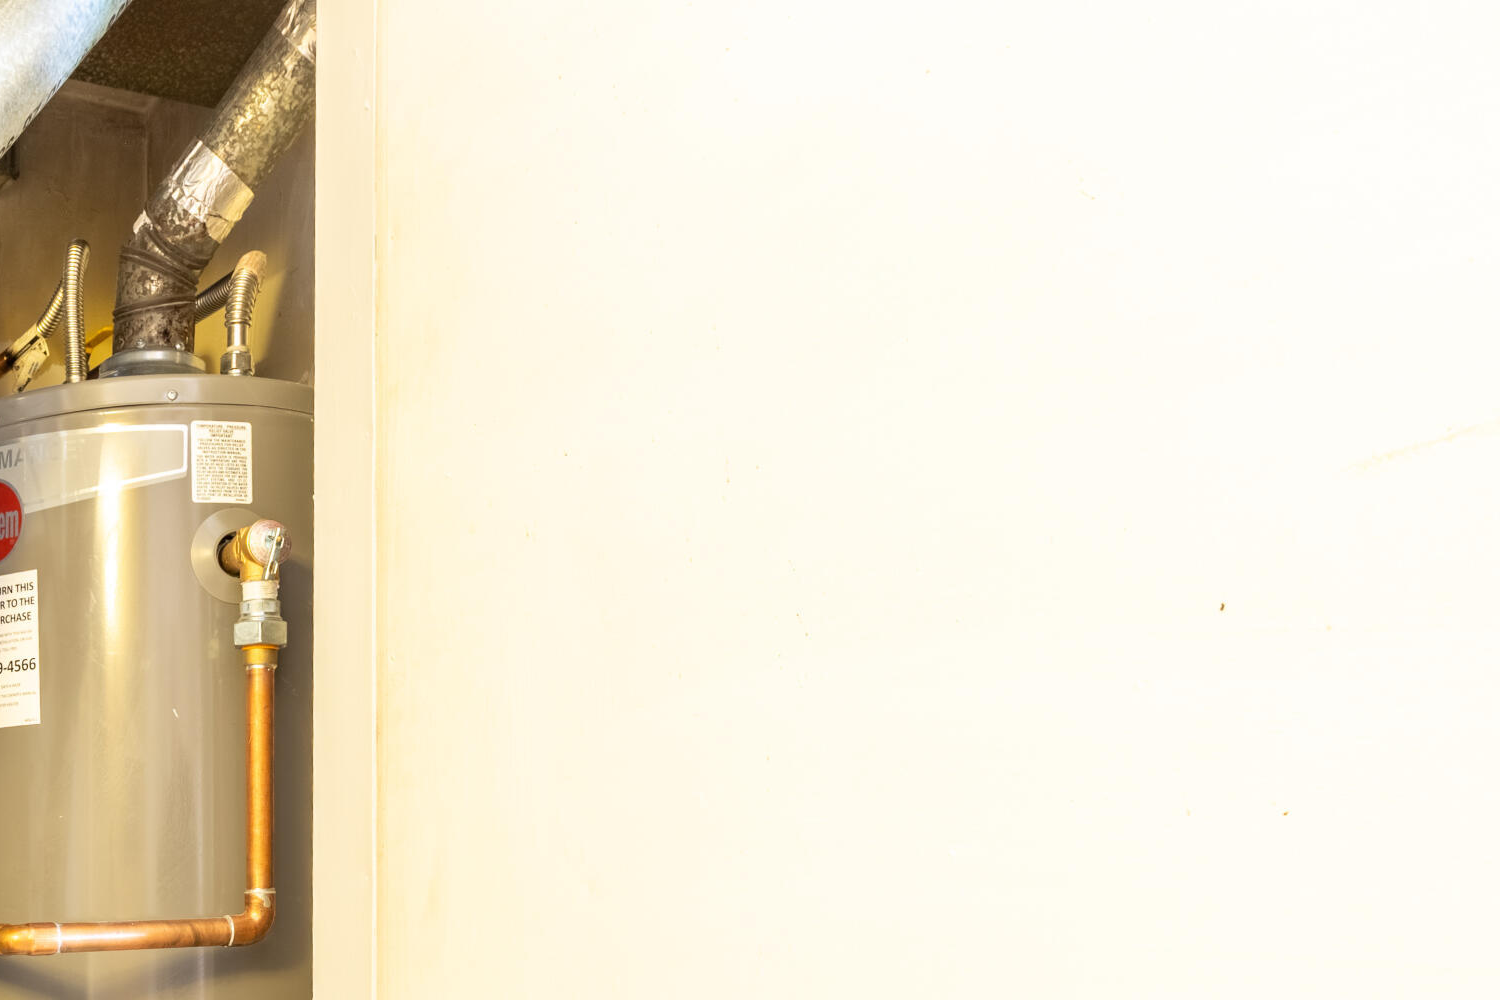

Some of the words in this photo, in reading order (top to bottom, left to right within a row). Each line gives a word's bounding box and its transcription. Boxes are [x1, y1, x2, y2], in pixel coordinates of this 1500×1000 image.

[15, 582, 34, 592] THIS
[7, 599, 17, 608] TO
[19, 596, 35, 606] THE
